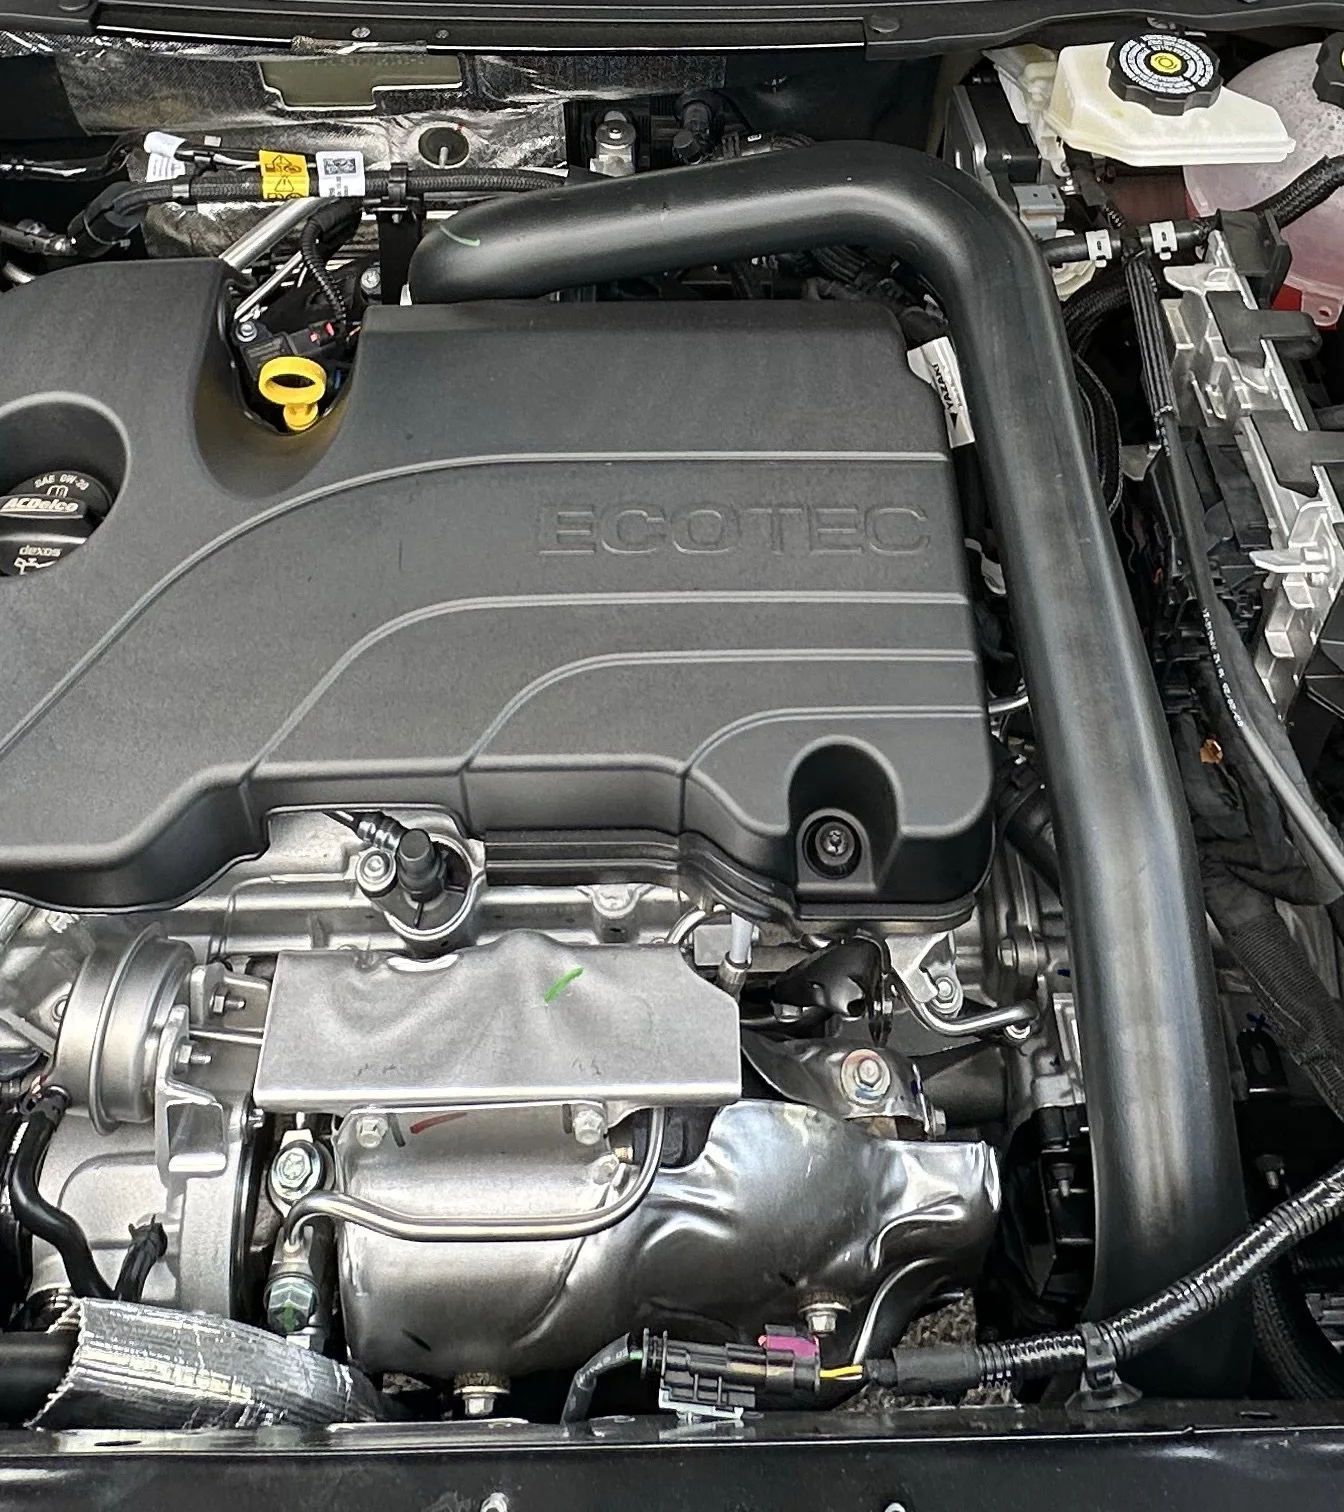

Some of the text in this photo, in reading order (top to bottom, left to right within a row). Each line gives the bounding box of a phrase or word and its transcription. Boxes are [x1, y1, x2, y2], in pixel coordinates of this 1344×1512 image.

[931, 363, 954, 411] YAZAKI
[35, 474, 56, 489] SAE
[0, 497, 79, 513] ACDelco
[537, 502, 931, 558] ECOTEC
[19, 545, 62, 558] dexos
